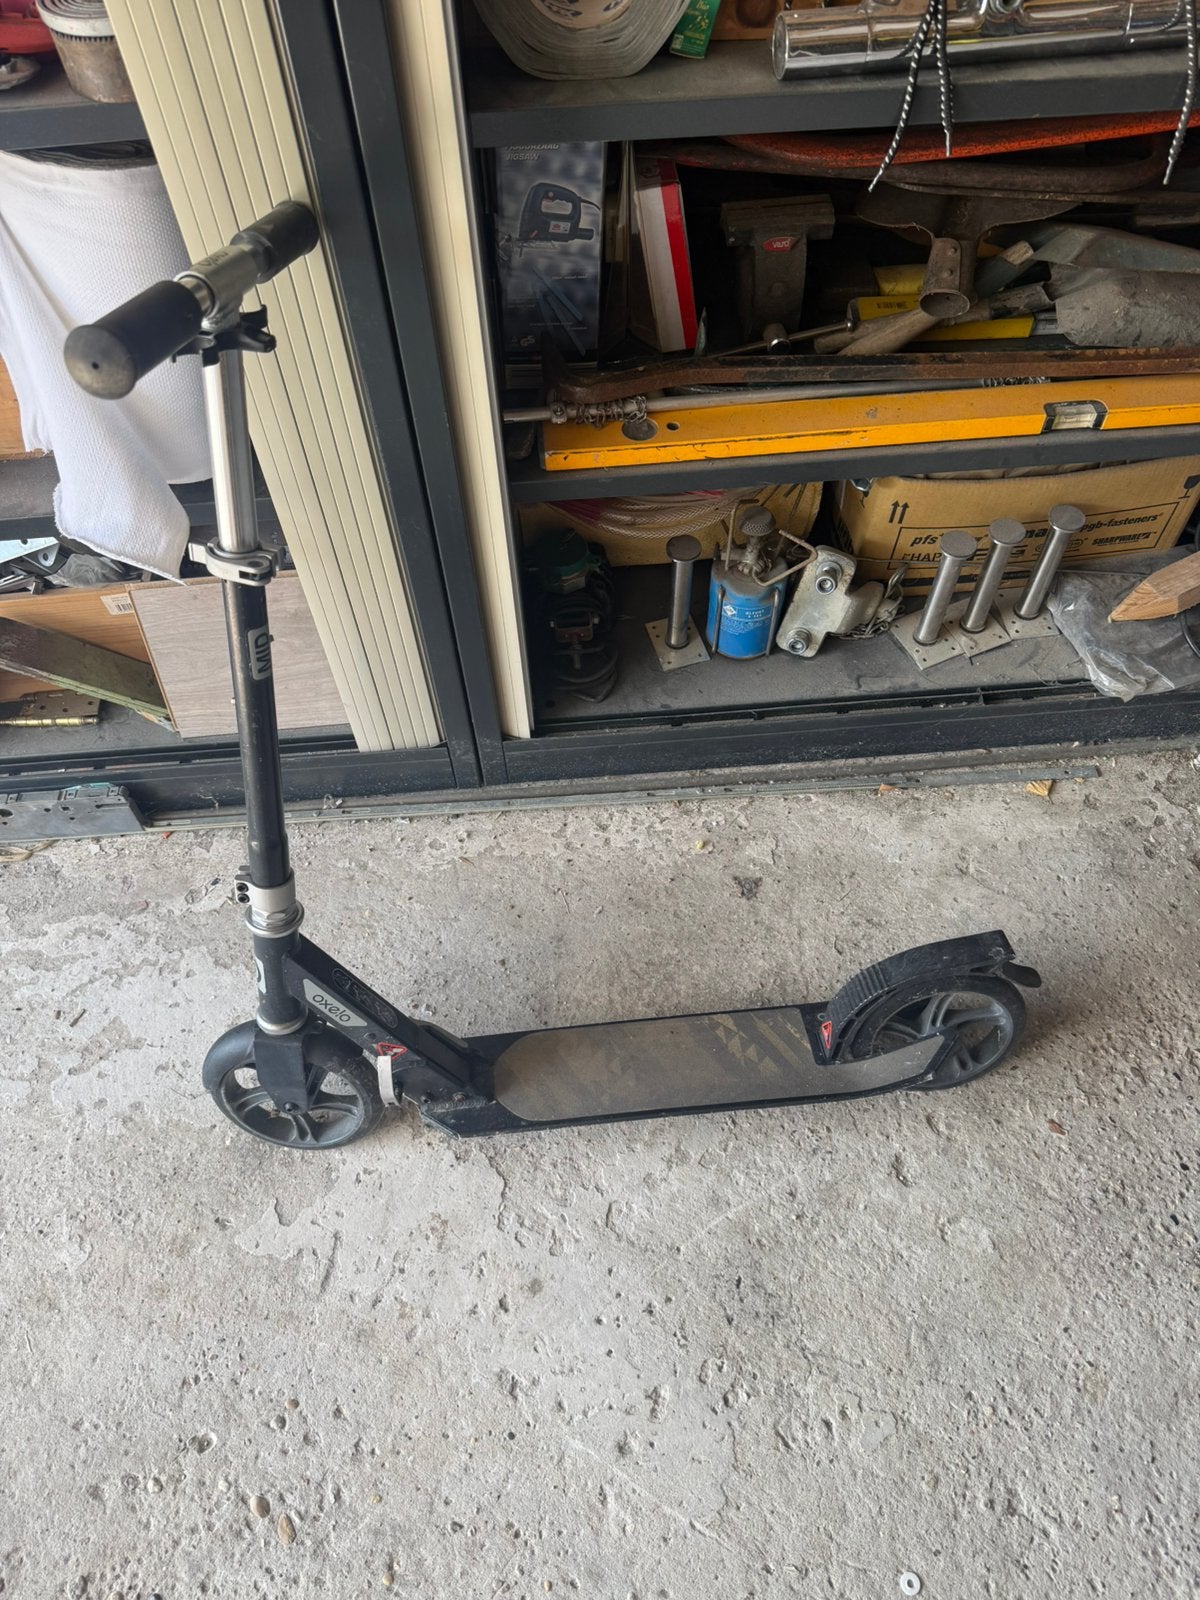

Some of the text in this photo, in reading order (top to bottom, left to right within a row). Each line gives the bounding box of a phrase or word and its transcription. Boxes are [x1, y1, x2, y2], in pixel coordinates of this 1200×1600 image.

[506, 153, 540, 161] JIGSAW
[1081, 514, 1158, 532] pgb-fasteners
[254, 633, 272, 673] MID
[312, 994, 351, 1023] oxelo
